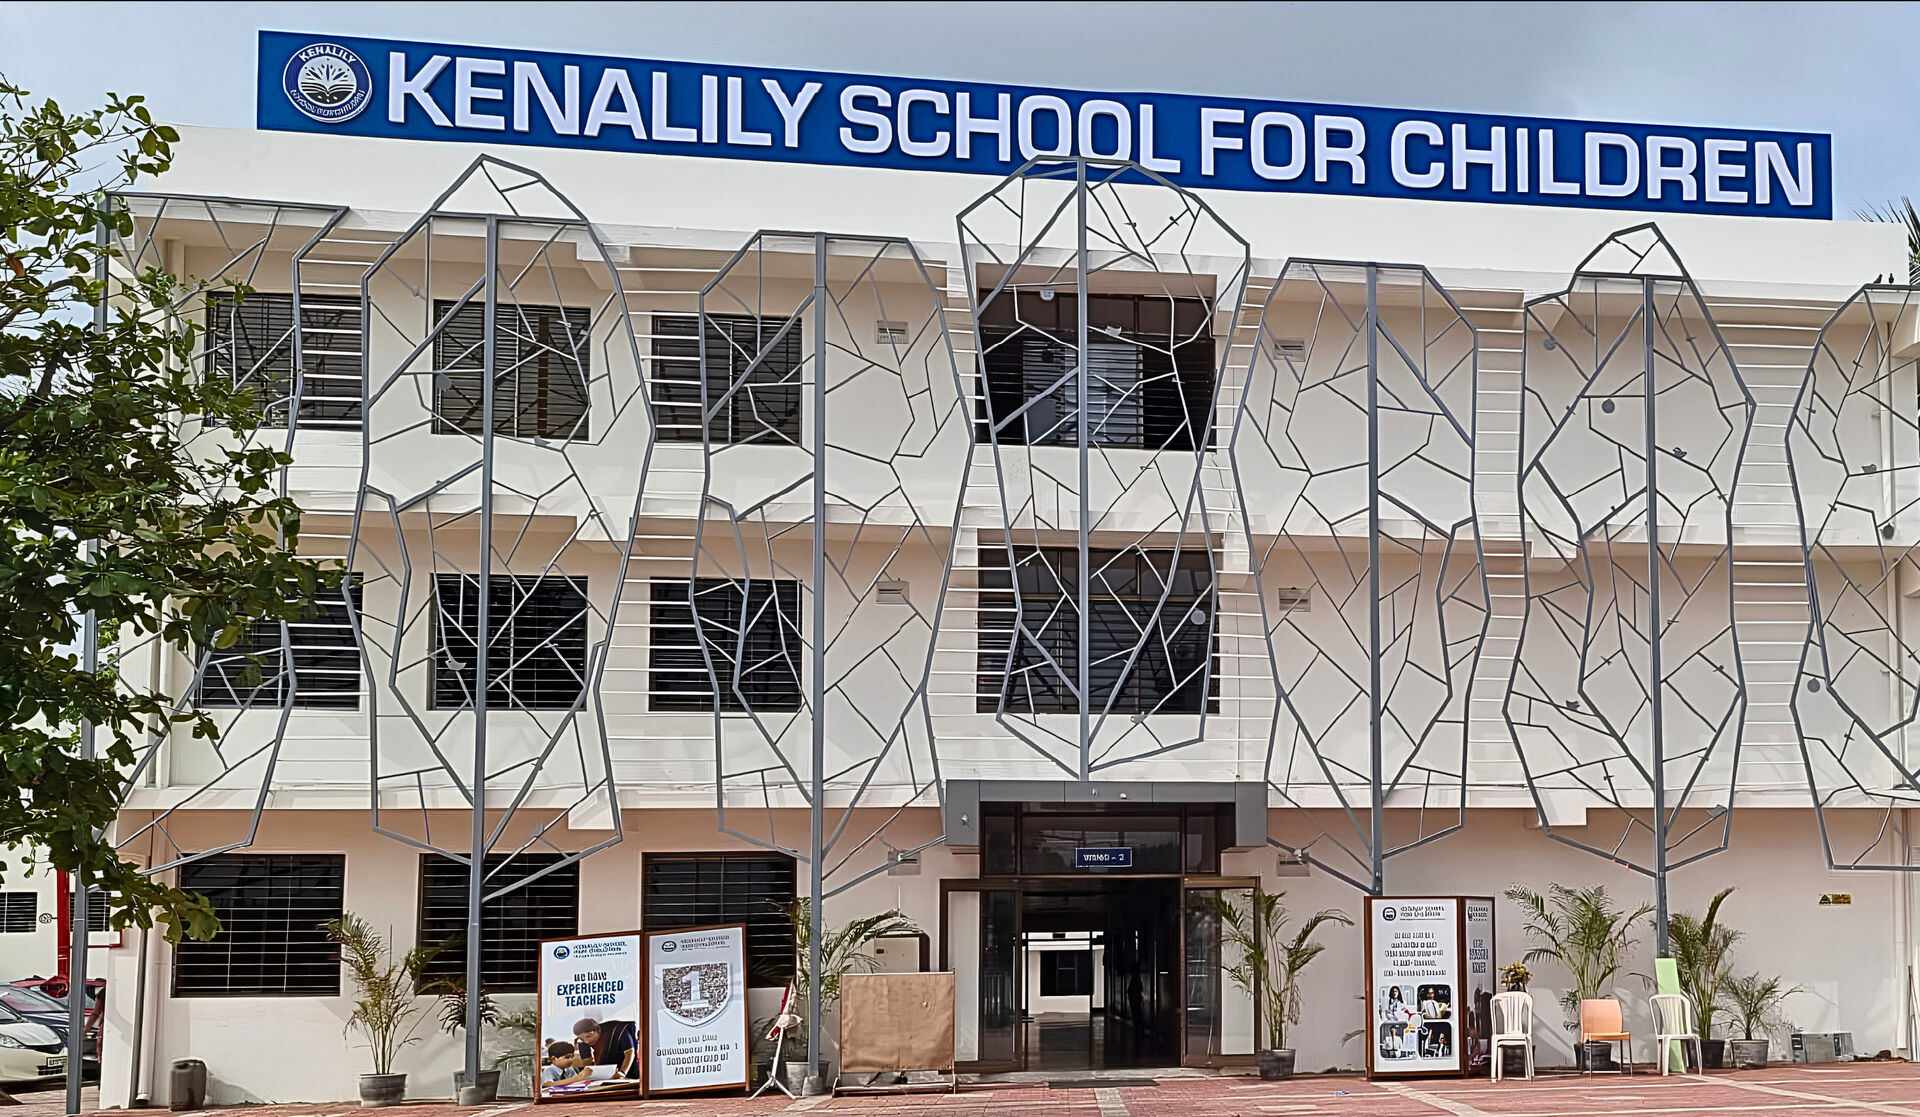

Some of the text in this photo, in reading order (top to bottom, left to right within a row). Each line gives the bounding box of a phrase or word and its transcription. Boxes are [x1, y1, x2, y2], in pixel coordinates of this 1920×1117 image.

[299, 46, 357, 63] KENALILY
[387, 51, 1813, 206] KENALILY SCHOOL FOR CHILDREN
[556, 979, 624, 996] EXPERIENCED
[565, 992, 616, 1007] TEACHERS
